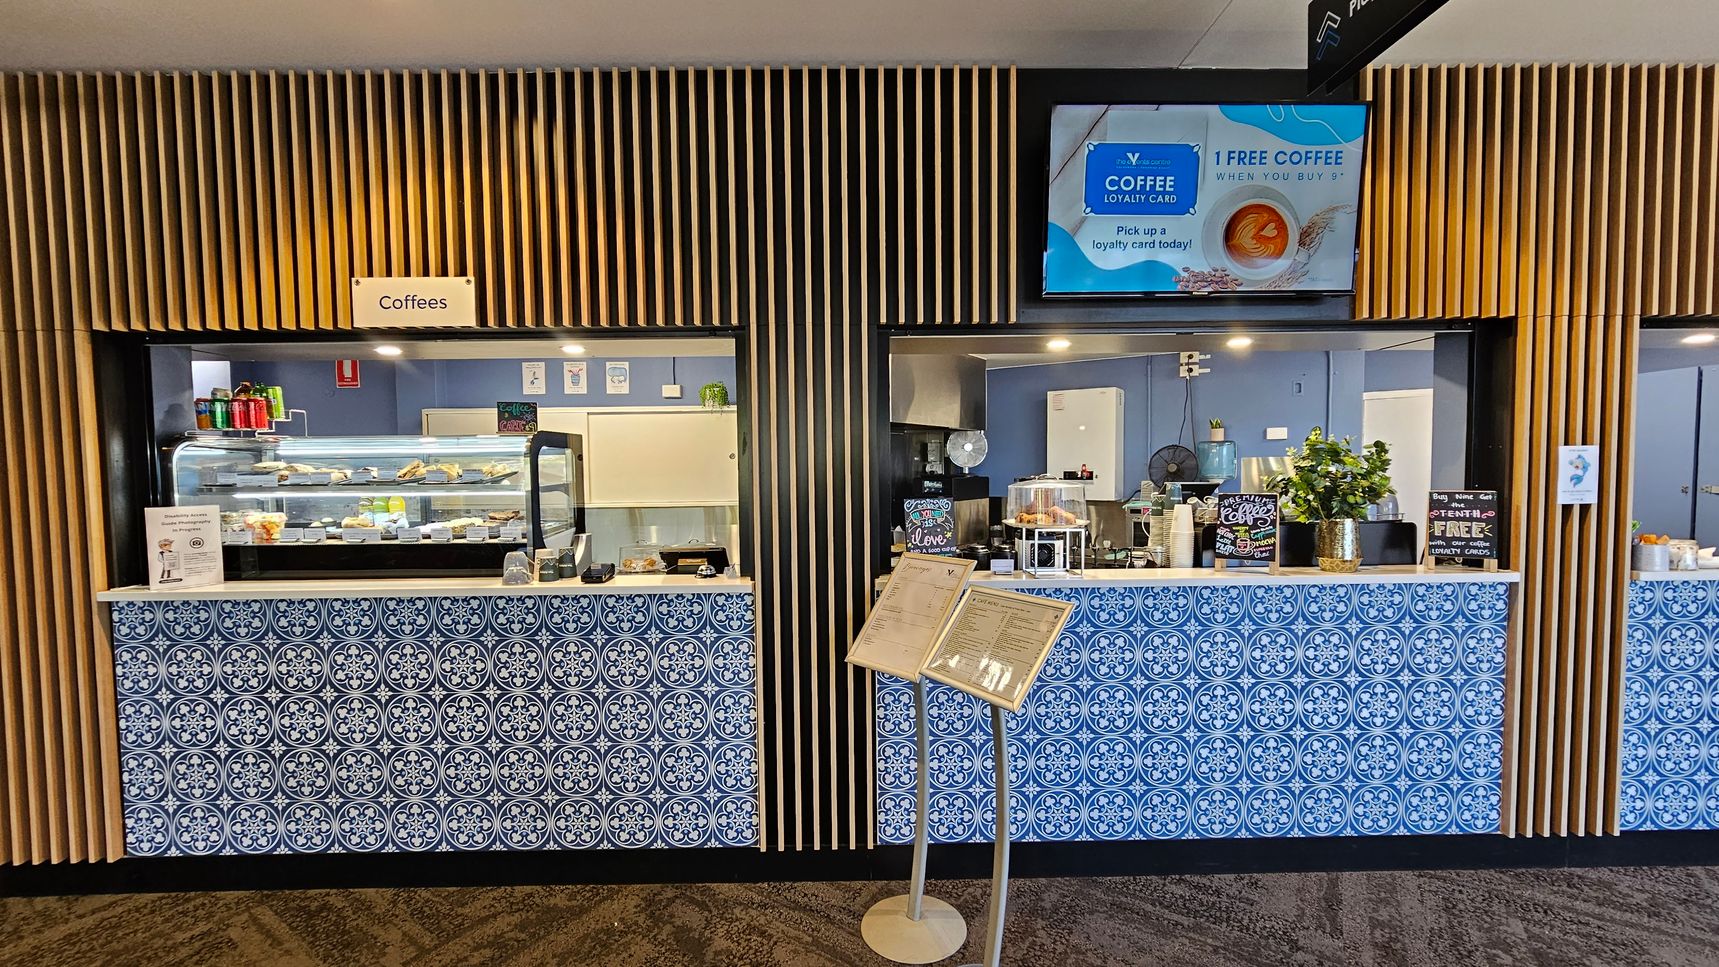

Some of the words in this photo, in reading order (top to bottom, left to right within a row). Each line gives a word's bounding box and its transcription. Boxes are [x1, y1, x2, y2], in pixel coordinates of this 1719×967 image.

[1215, 150, 1221, 166] 1
[1226, 150, 1268, 166] FREE
[1274, 150, 1344, 166] COFFEE
[1216, 172, 1255, 181] WHEN
[1263, 172, 1290, 181] YOU
[1297, 172, 1323, 181] BUY
[1105, 175, 1175, 192] COFFEE
[1104, 194, 1146, 203] LOYALTY
[1149, 194, 1177, 203] CARD
[1116, 225, 1140, 236] Pick
[1143, 227, 1157, 237] up
[1160, 227, 1167, 235] a
[1092, 239, 1128, 251] loyalty
[1131, 239, 1156, 249] card
[1158, 239, 1192, 251] today!
[379, 294, 448, 310] Coffees
[499, 402, 532, 415] Coffee
[1223, 494, 1269, 507] PREMIUM
[1432, 492, 1448, 502] Buy
[1220, 502, 1275, 526] Coffee
[1434, 520, 1486, 538] FREE
[1256, 537, 1277, 546] MOCHA
[1469, 540, 1491, 548] coffee
[1431, 547, 1461, 555] LOYALTY
[1465, 548, 1491, 556] CARDS
